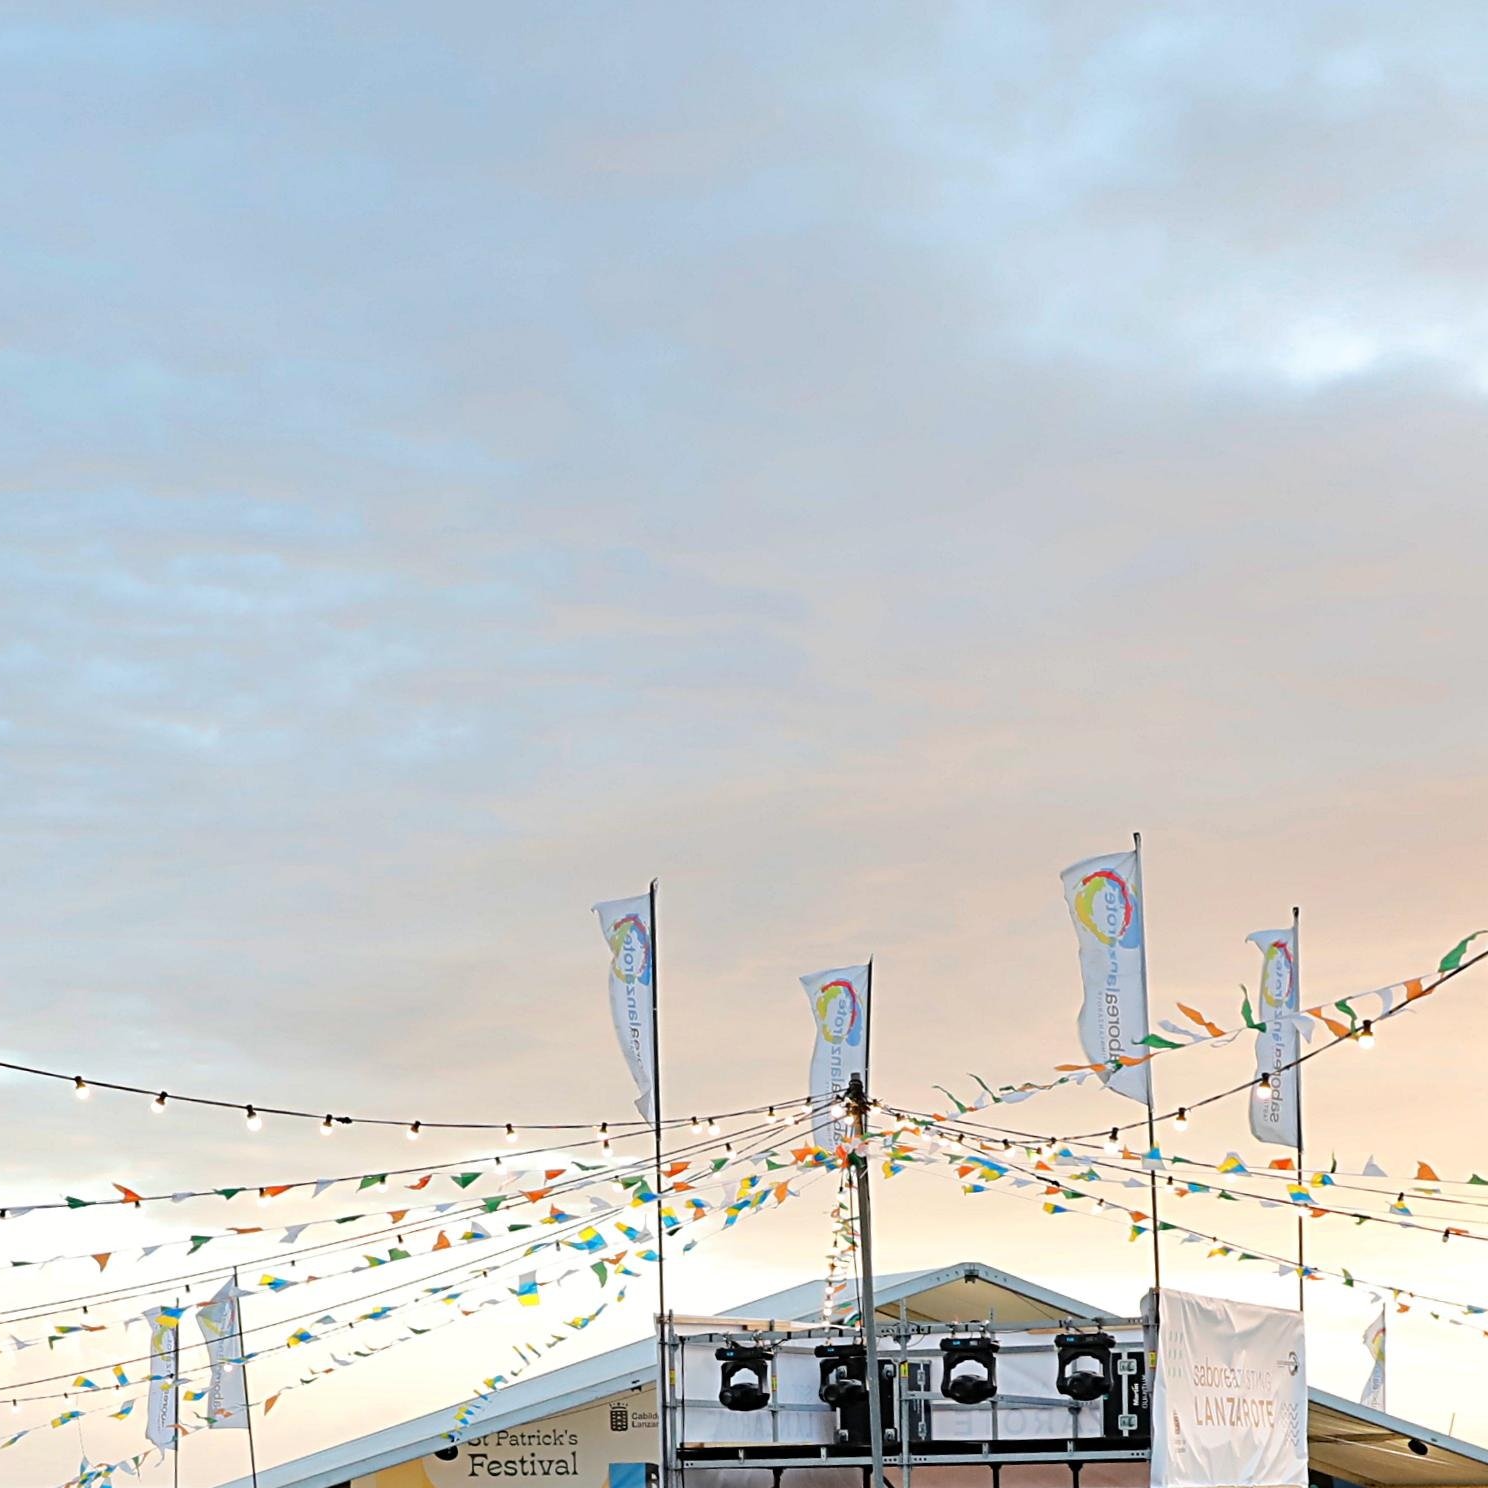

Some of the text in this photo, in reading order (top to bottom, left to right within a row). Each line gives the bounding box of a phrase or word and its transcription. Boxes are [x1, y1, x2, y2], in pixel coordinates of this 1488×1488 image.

[631, 1412, 658, 1420] Cabild
[1194, 1396, 1274, 1428] LANZAROTE
[496, 1429, 578, 1447] Patrick's
[468, 1451, 579, 1477] Festival
